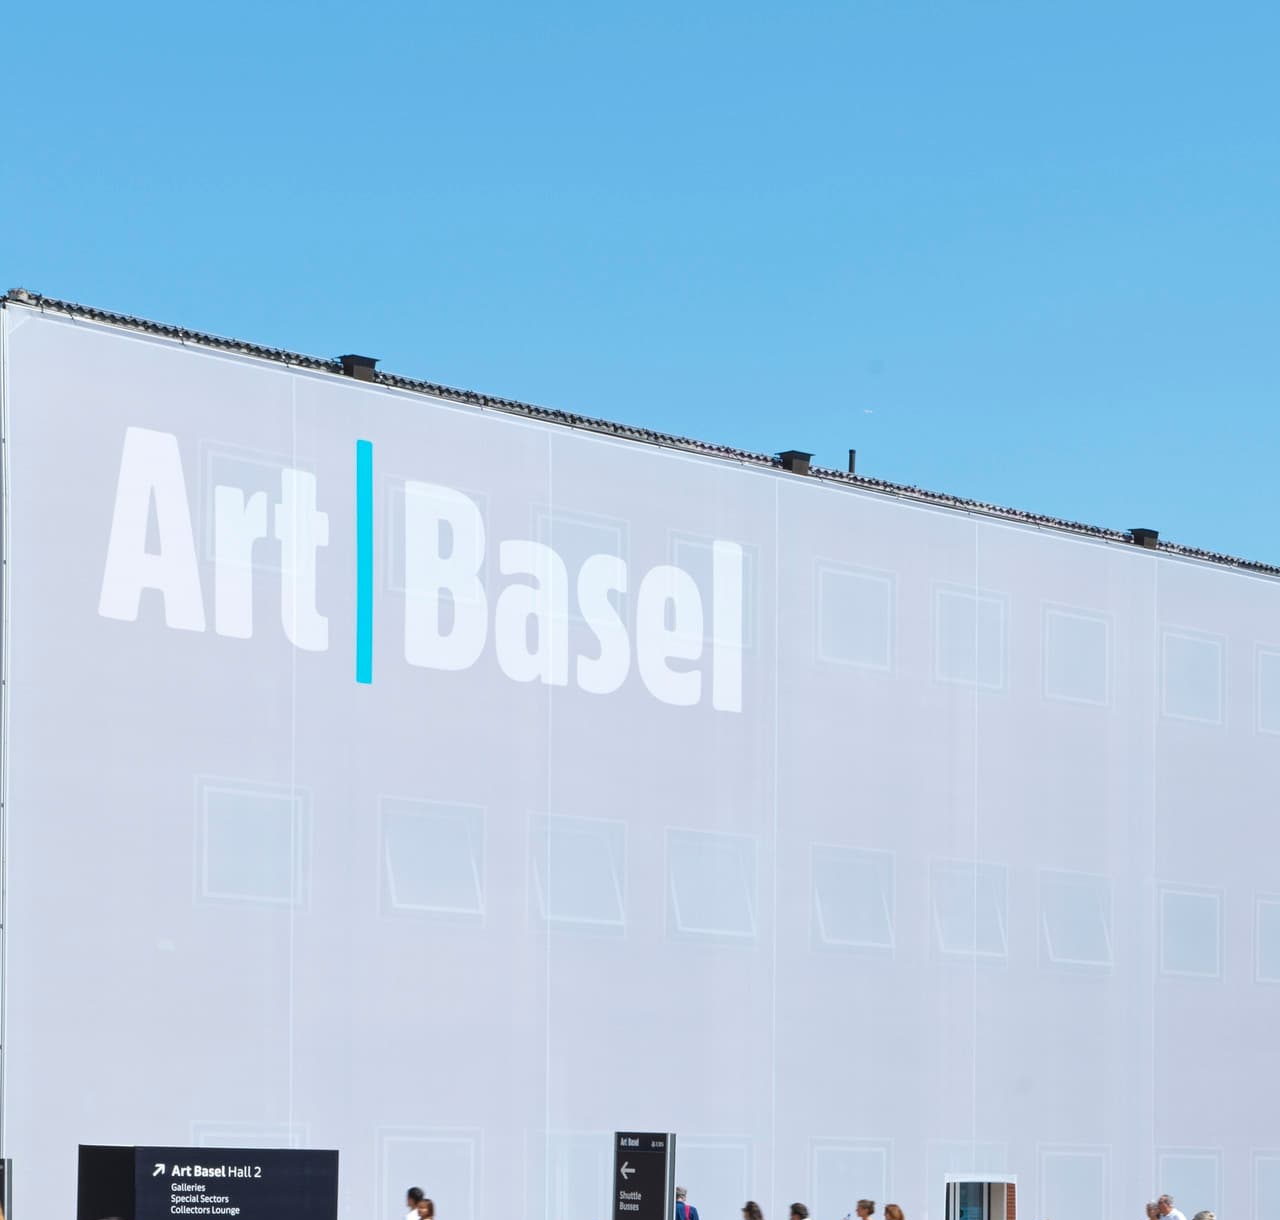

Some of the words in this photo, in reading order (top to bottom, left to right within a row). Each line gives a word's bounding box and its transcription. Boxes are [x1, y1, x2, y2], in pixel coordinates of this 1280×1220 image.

[98, 426, 329, 652] Art
[404, 480, 744, 713] Basel
[172, 1165, 192, 1177] Art
[193, 1165, 226, 1178] Basel
[227, 1166, 251, 1178] Hall
[254, 1167, 262, 1178] 2
[171, 1183, 206, 1192] Galleries
[170, 1194, 199, 1204] Special
[200, 1195, 229, 1203] Sectors
[619, 1191, 641, 1200] Shuttle
[170, 1205, 211, 1215] Collectors
[211, 1206, 240, 1216] Lounge
